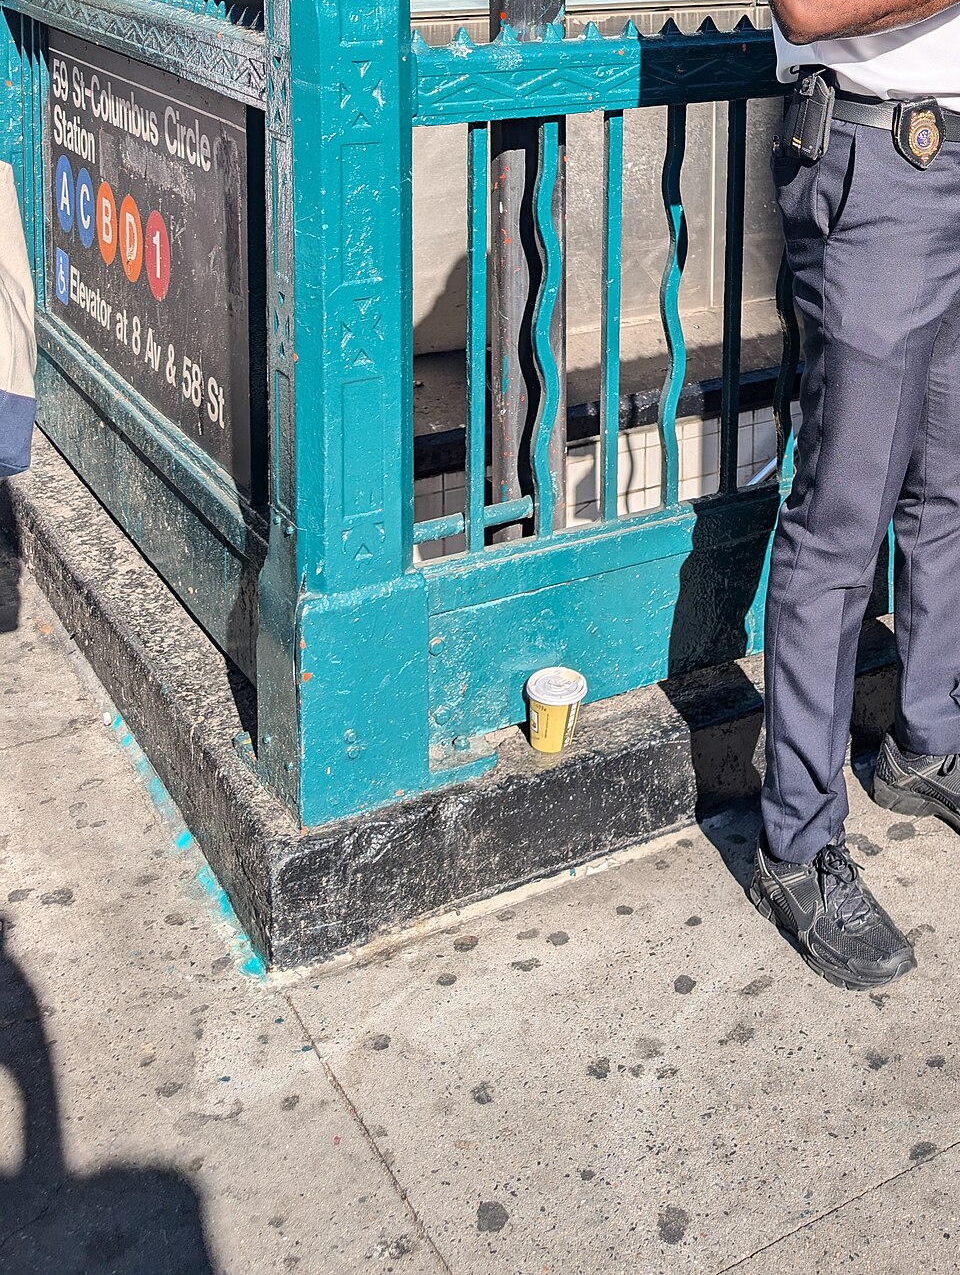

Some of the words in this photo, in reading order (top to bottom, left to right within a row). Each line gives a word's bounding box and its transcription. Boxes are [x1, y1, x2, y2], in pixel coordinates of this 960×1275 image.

[52, 58, 69, 102] 59
[72, 66, 159, 146] St-Columbus
[164, 106, 212, 172] Circle
[53, 104, 96, 164] Station
[60, 171, 71, 216] A
[79, 183, 91, 229] C
[101, 196, 113, 245] B
[125, 212, 138, 262] D
[152, 230, 161, 279] 1
[69, 268, 112, 331] Elevator
[116, 310, 128, 345] at
[132, 316, 141, 356] 8
[145, 328, 162, 372] Av
[165, 343, 176, 387] &
[182, 356, 202, 408] 58
[207, 376, 226, 429] St
